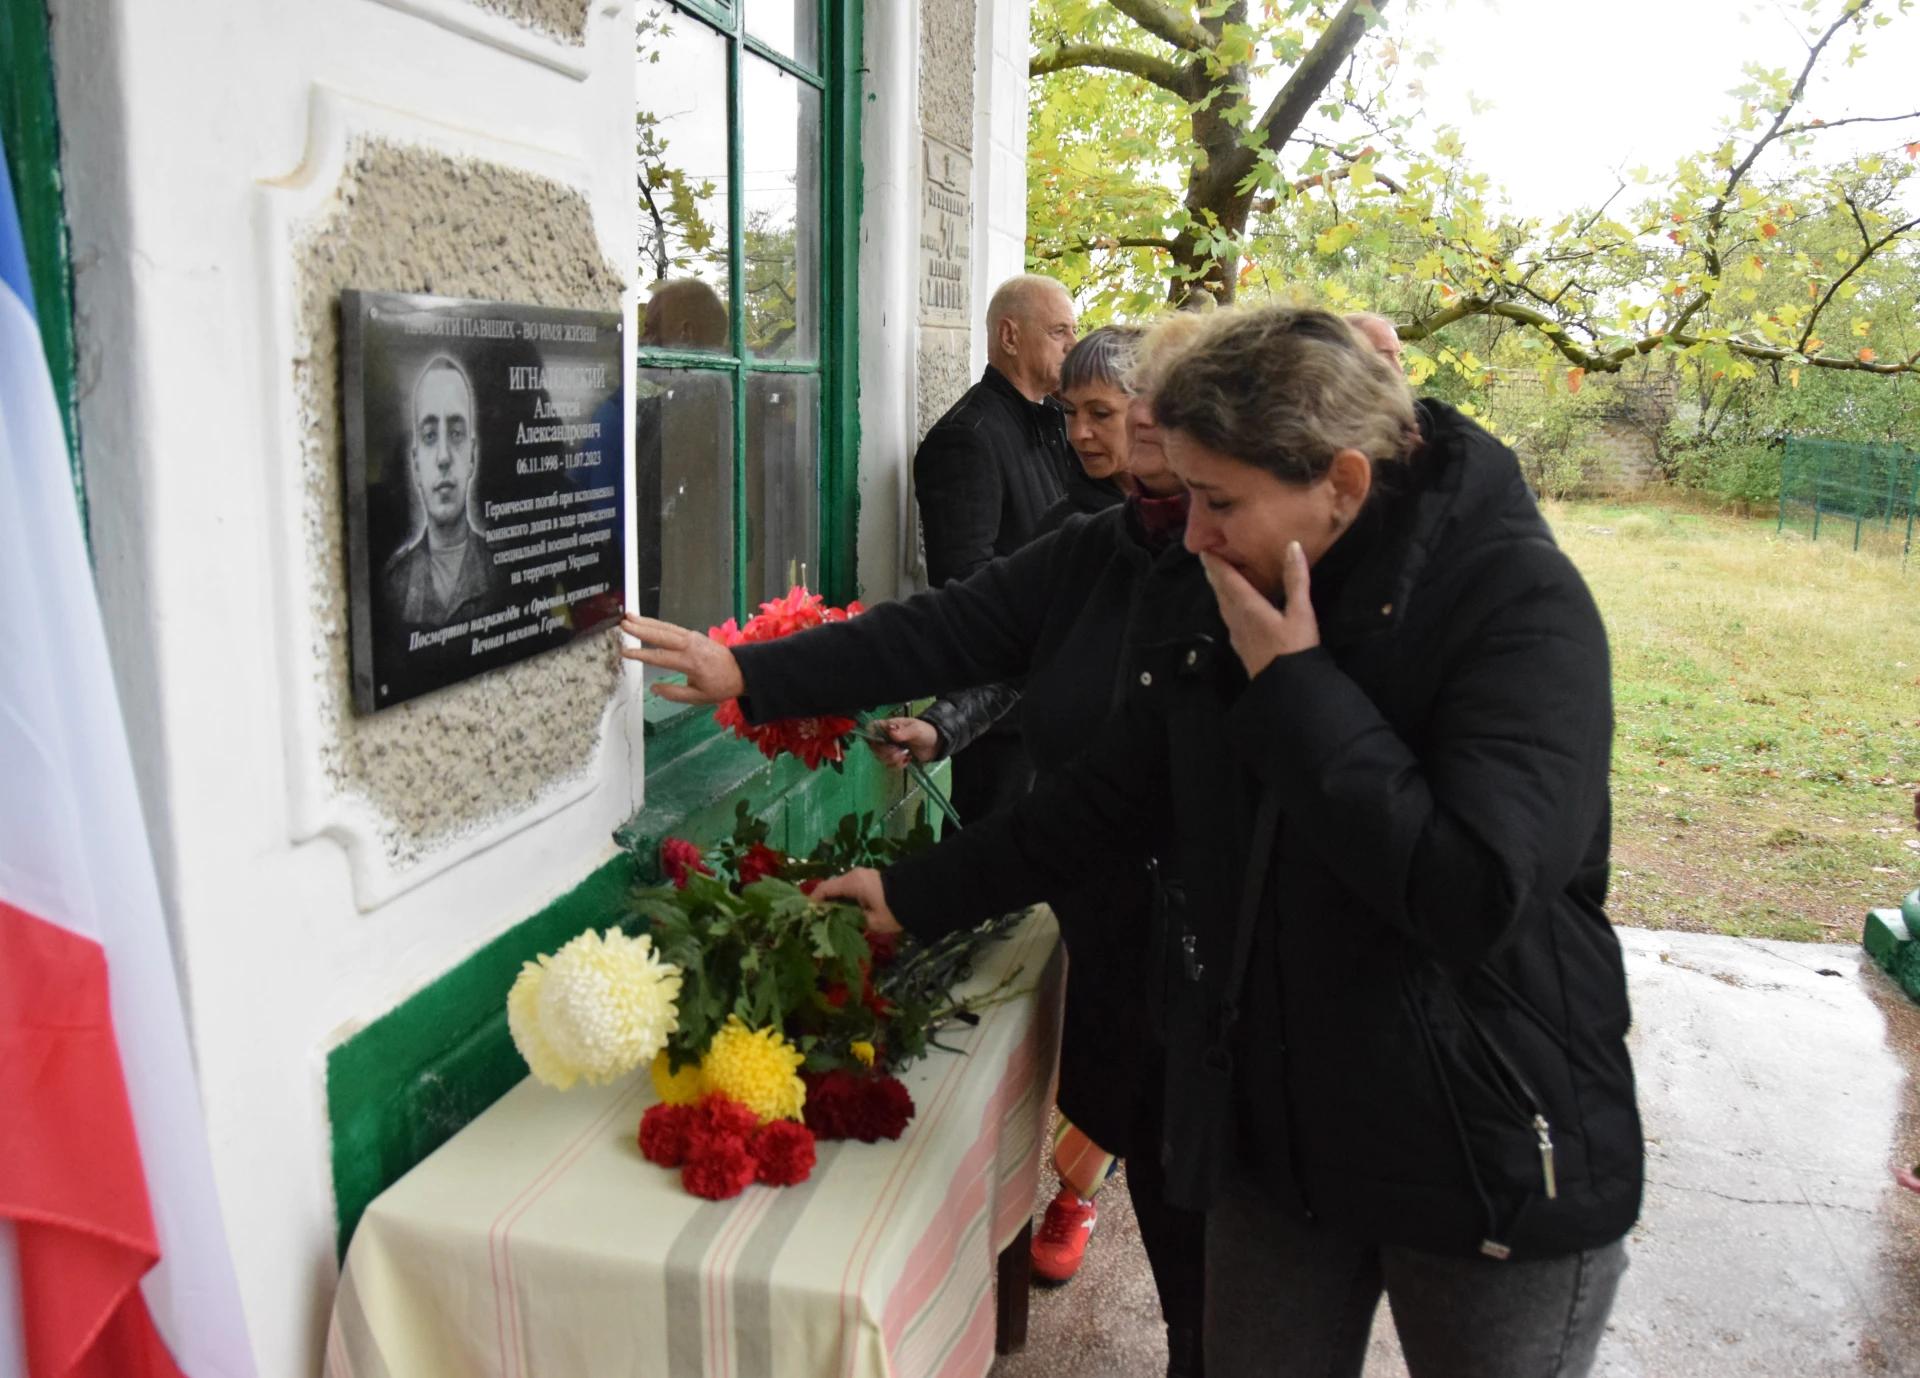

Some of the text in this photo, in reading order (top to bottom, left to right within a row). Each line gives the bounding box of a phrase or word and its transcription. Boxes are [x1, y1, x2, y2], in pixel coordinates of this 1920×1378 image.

[464, 318, 516, 339] ПАВШИХ
[522, 322, 537, 340] ВО
[516, 422, 601, 446] Александрович
